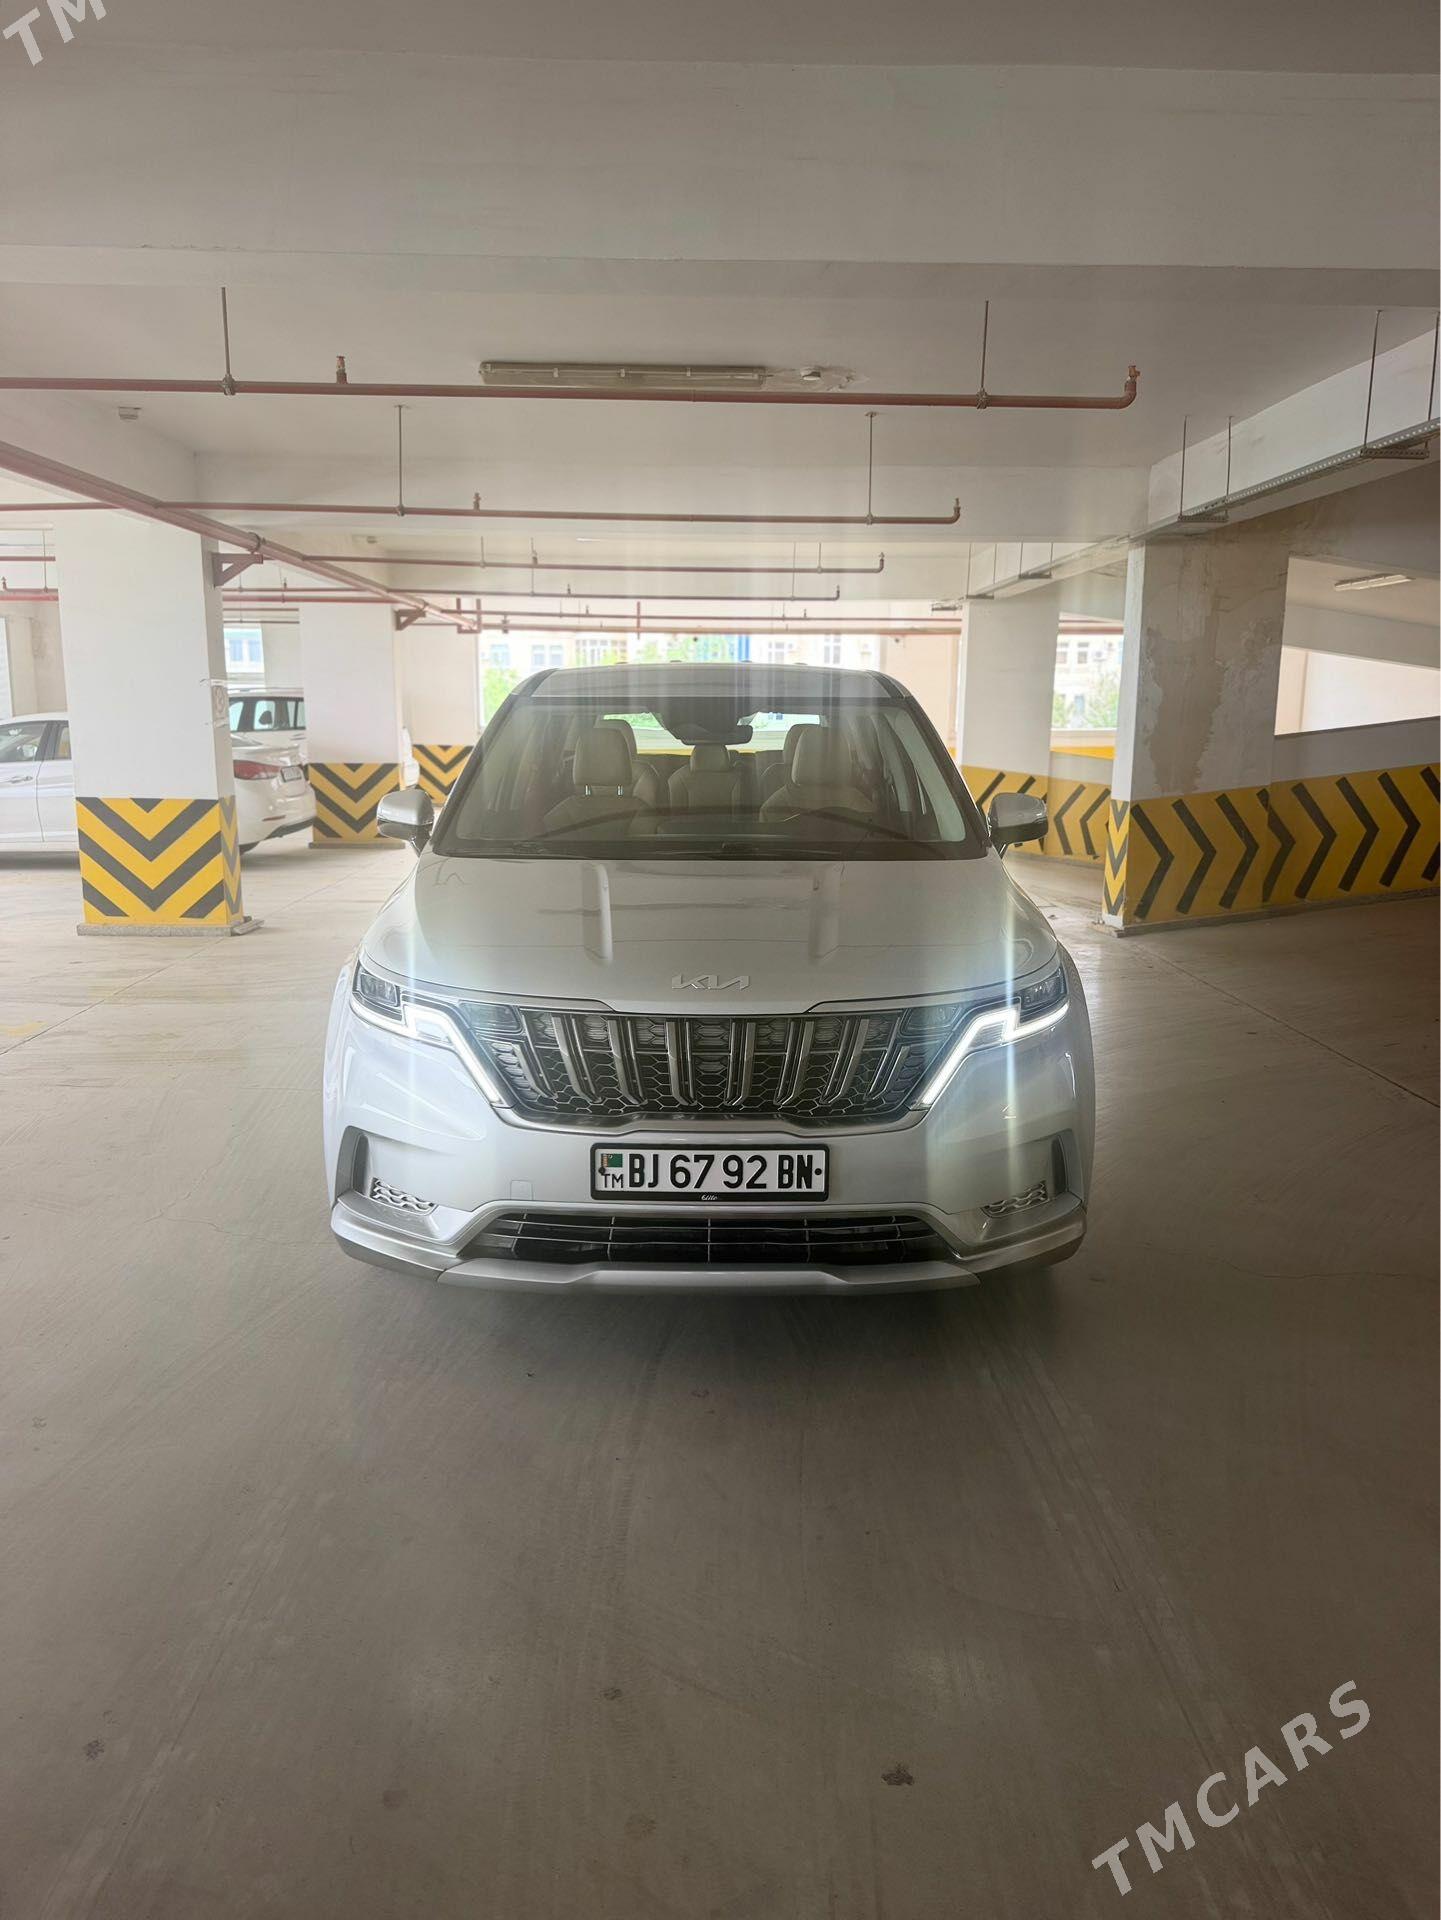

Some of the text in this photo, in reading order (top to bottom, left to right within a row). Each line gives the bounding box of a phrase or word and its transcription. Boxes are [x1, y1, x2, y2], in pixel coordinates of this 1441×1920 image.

[671, 974, 750, 990] KIA
[629, 1153, 659, 1188] BJ
[778, 1154, 813, 1189] BN
[602, 1173, 624, 1188] TM
